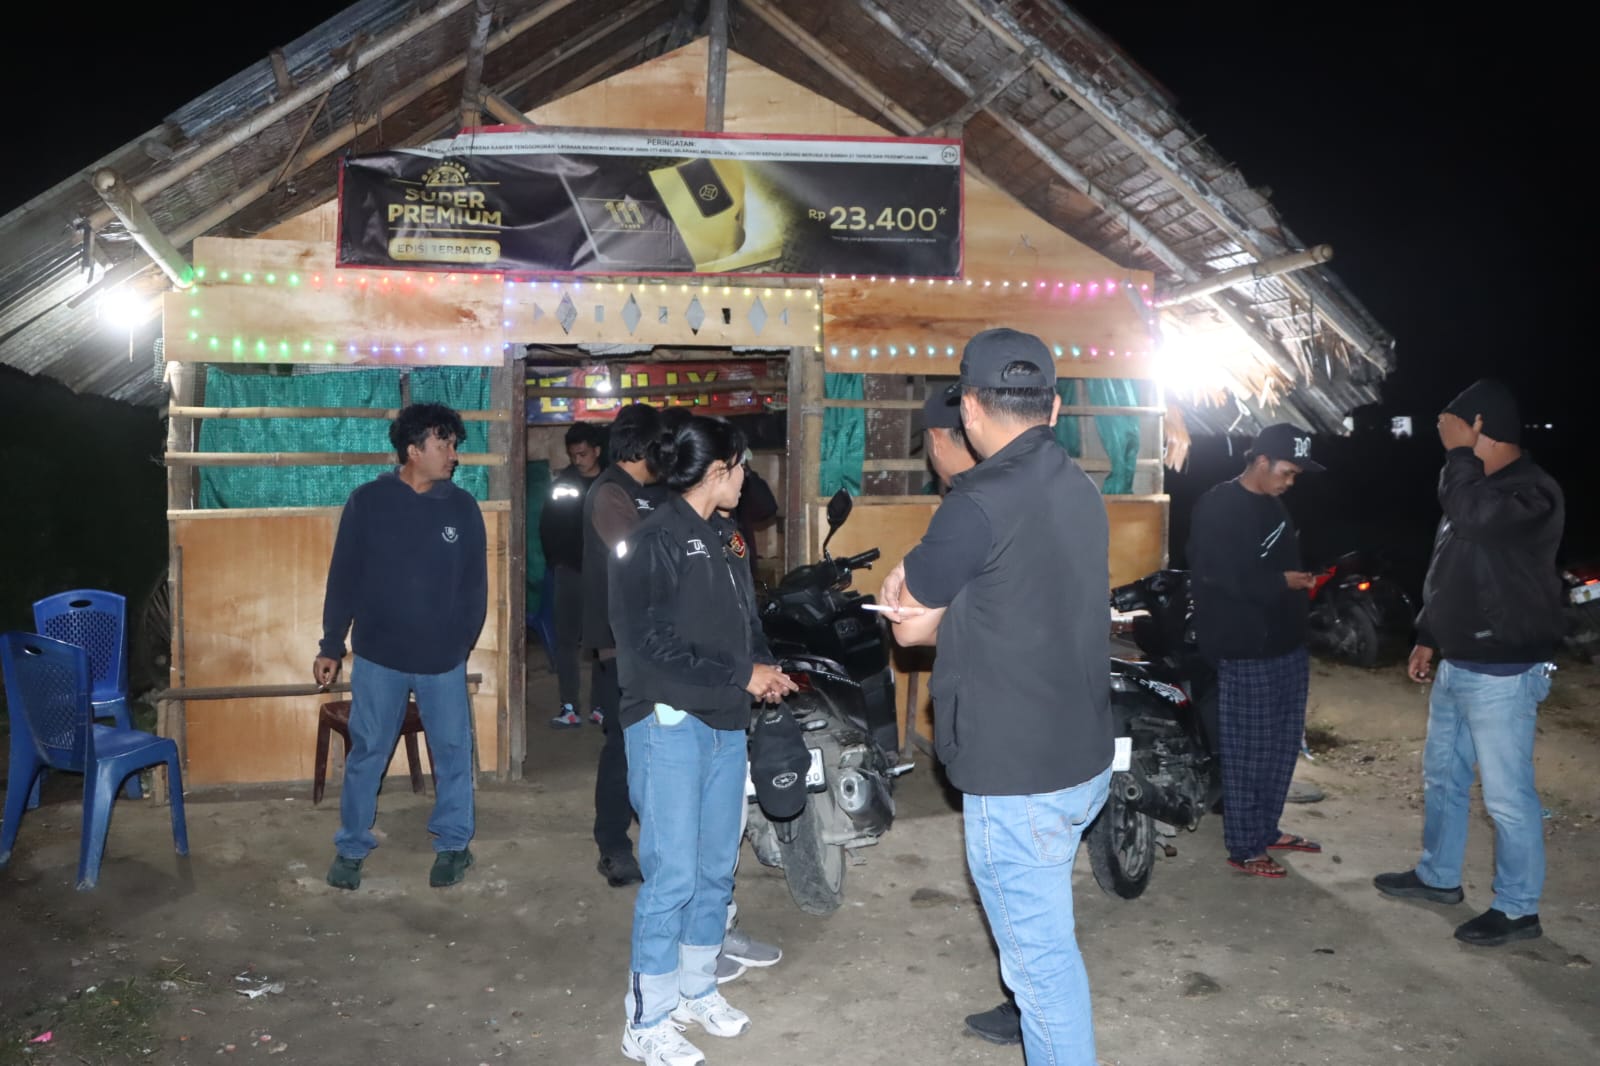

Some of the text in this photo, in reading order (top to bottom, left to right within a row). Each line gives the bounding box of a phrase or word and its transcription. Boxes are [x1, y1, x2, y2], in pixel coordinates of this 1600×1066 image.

[647, 138, 696, 147] PERINGATAN:
[405, 188, 485, 208] SUPER
[388, 204, 502, 226] PREMIUM
[809, 208, 826, 222] Rp
[397, 243, 492, 256] EDISI TERBATAS
